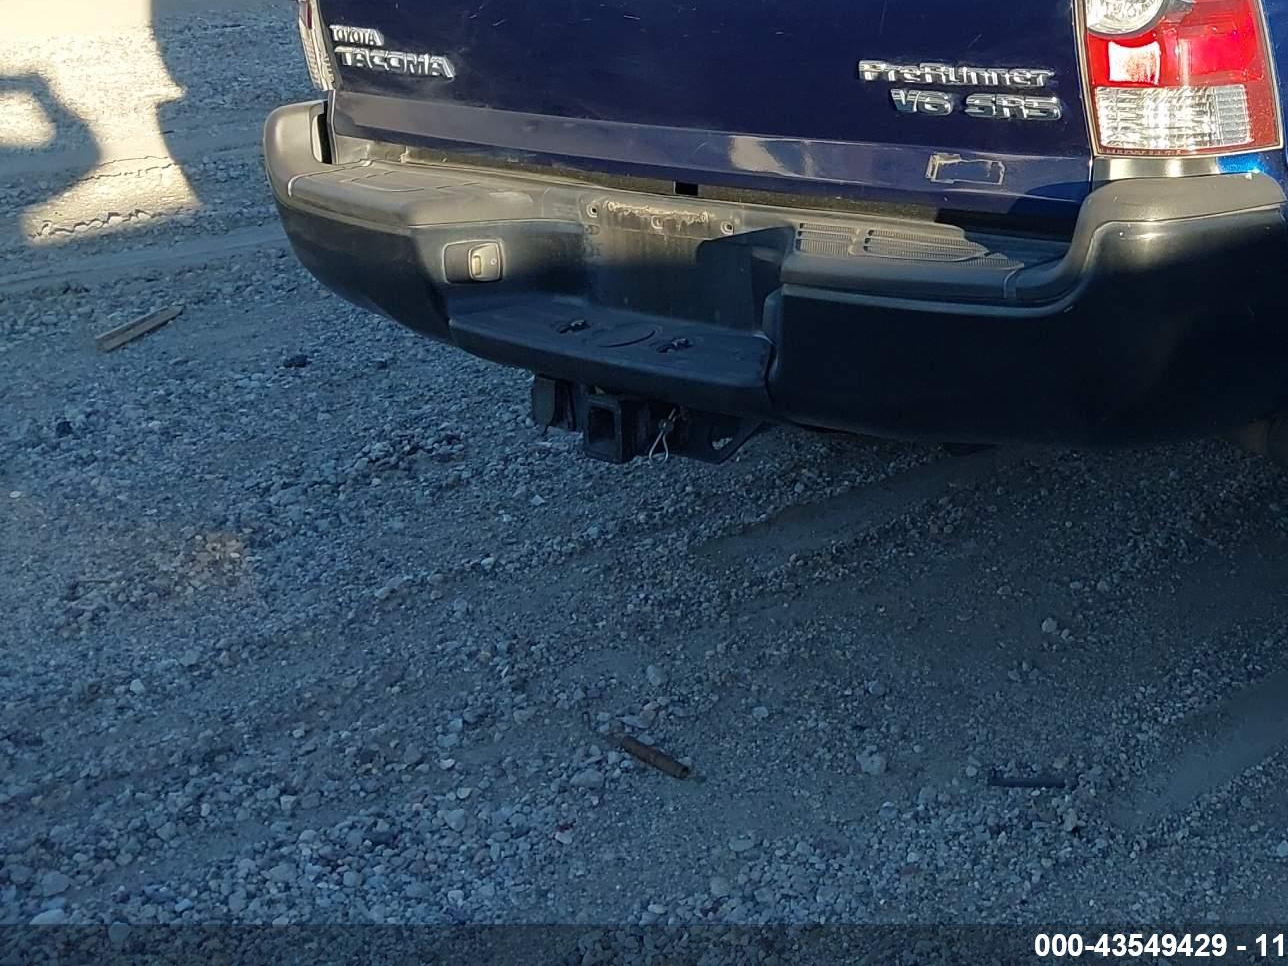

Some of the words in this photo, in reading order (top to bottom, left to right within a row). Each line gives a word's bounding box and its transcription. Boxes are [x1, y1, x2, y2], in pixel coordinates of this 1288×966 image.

[329, 24, 386, 48] TOYOTA
[334, 46, 457, 82] TACOMA
[858, 59, 1055, 87] PreRunner
[889, 88, 954, 117] V6
[964, 92, 1063, 121] SR5
